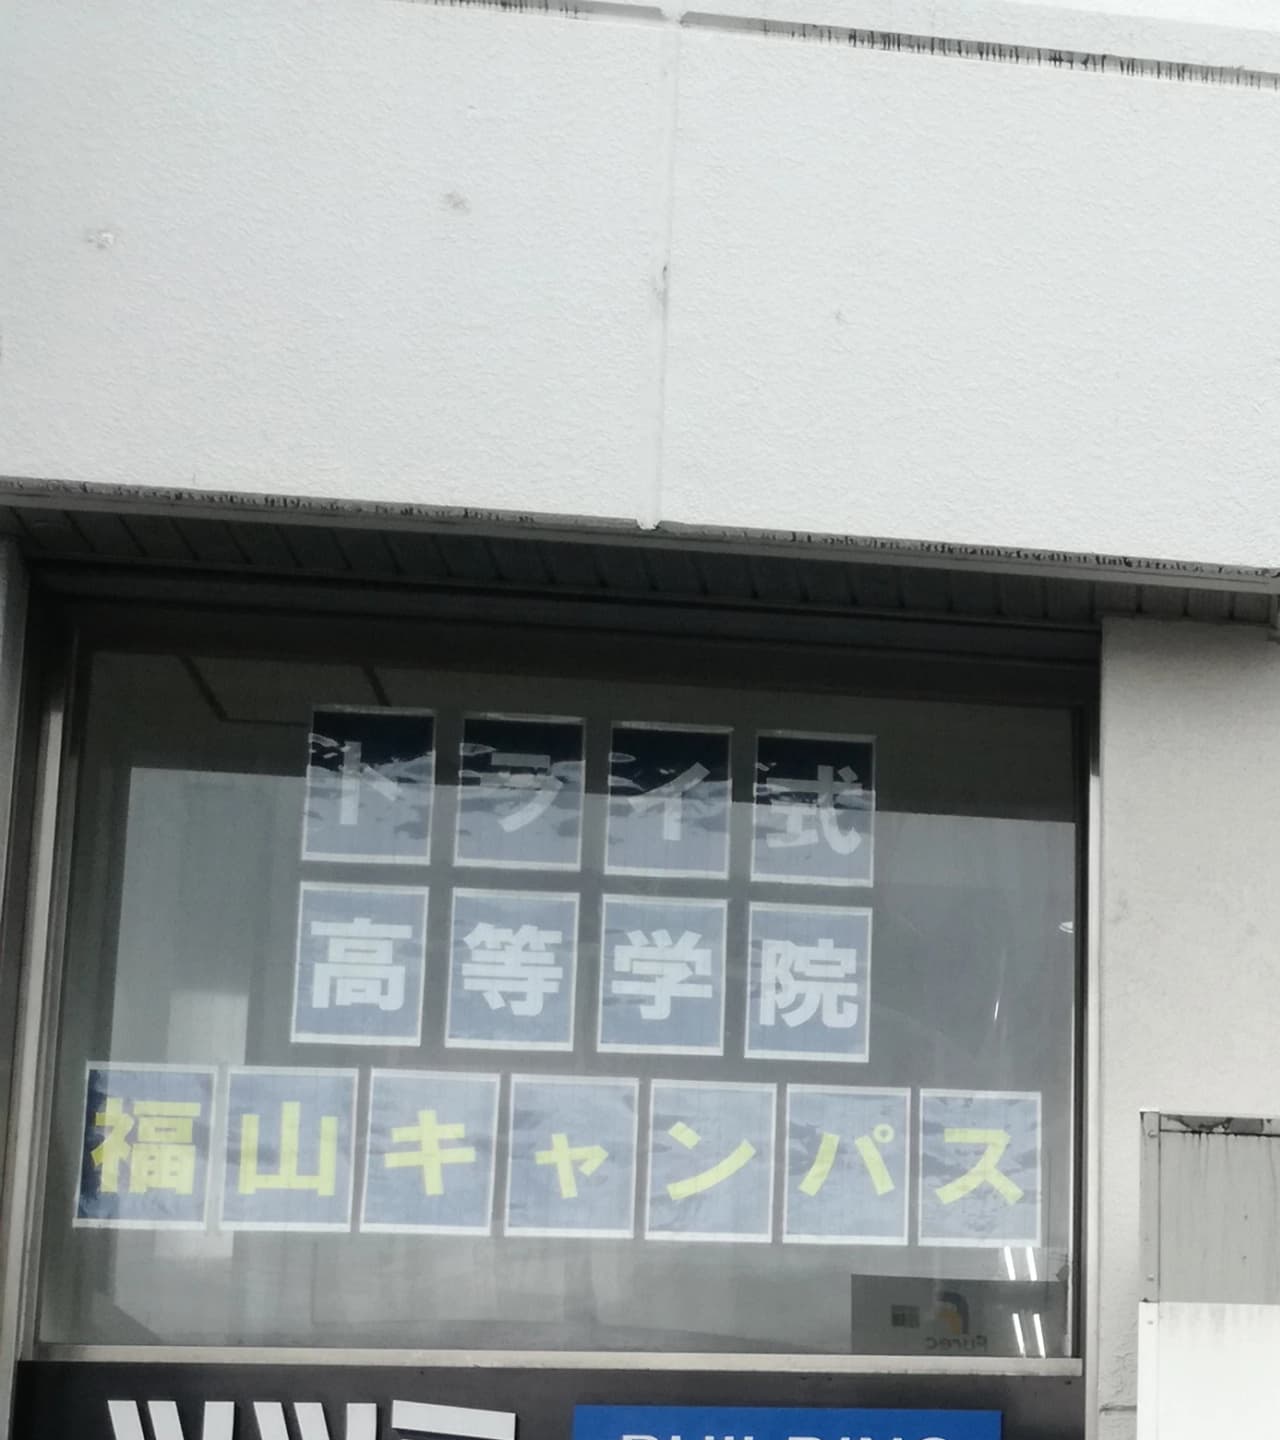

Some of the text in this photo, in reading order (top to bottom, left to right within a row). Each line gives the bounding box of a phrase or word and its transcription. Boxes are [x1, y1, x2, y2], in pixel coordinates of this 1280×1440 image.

[337, 741, 864, 856] トライ式
[309, 917, 860, 1028] 高等学院
[93, 1099, 1025, 1206] 福山キャンパス
